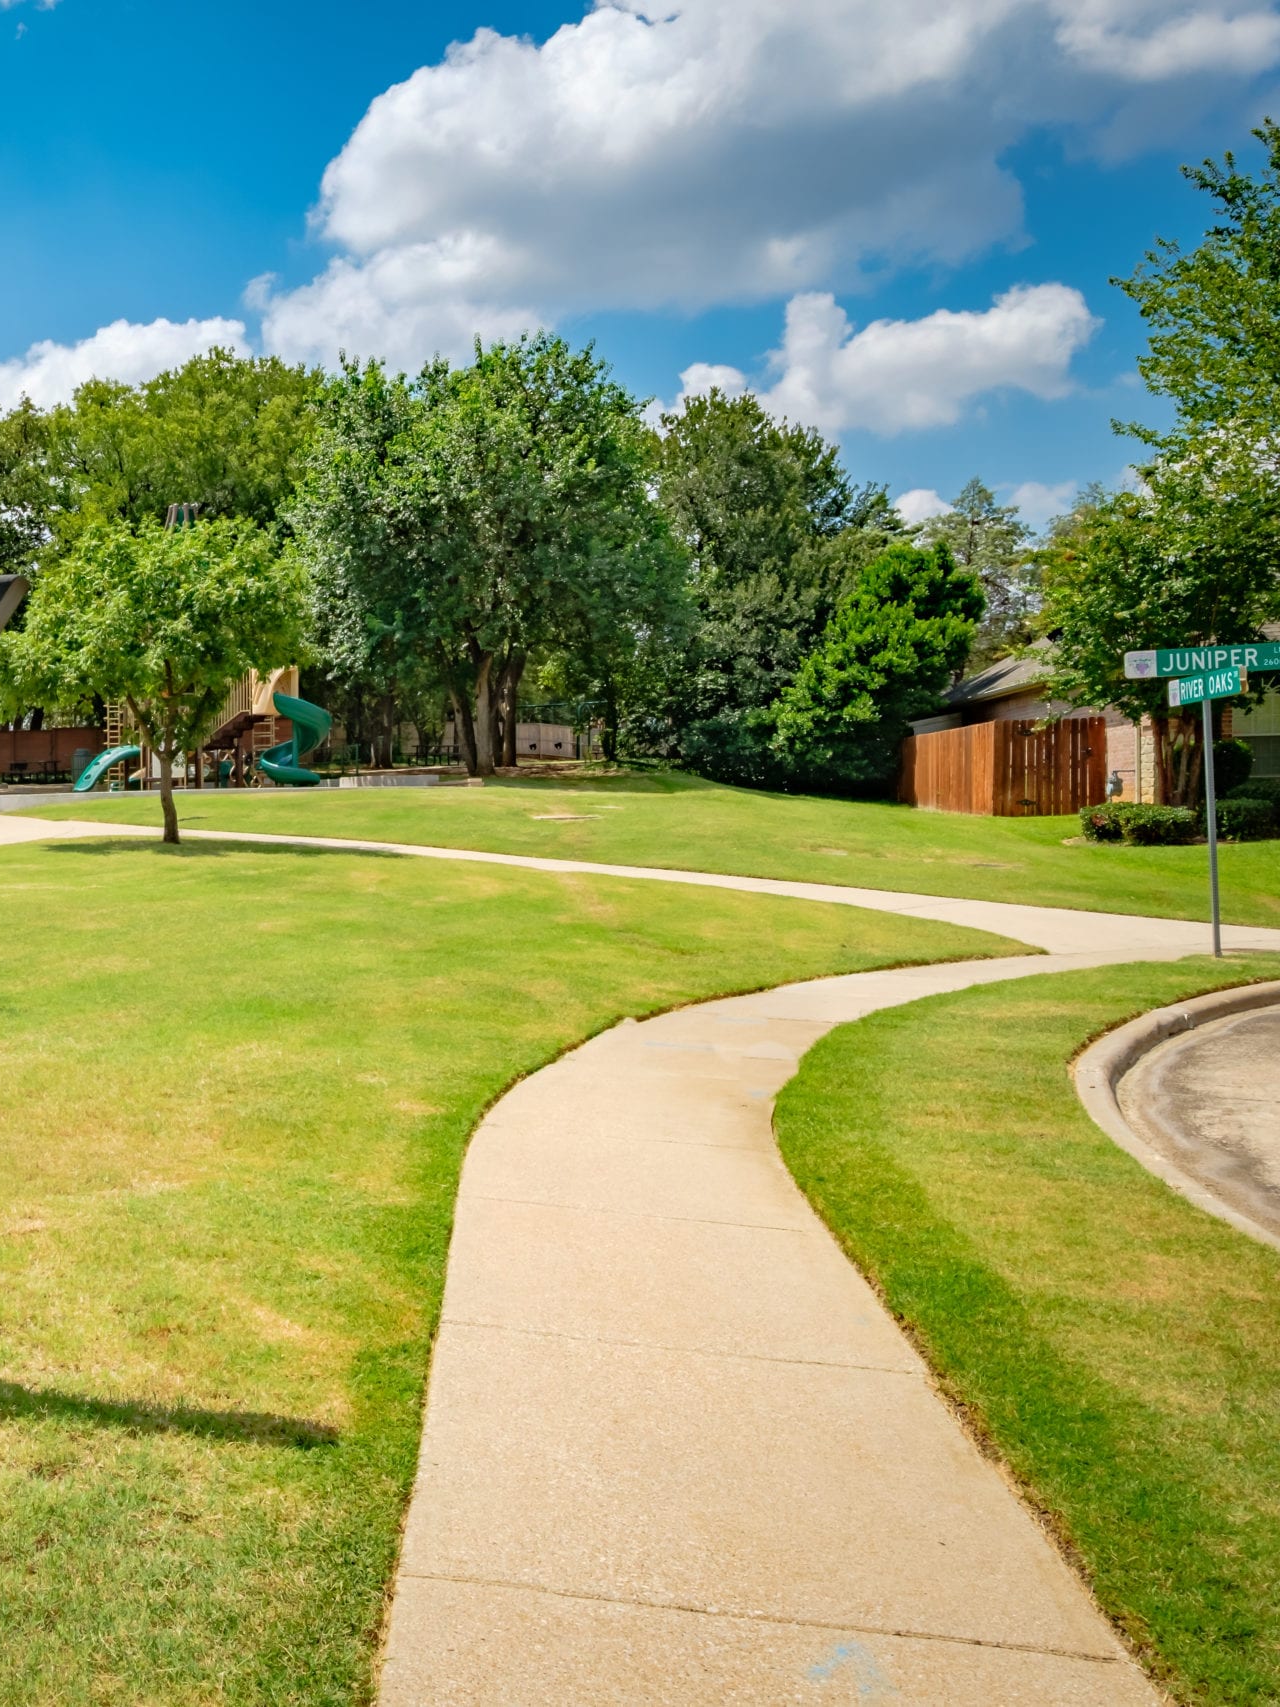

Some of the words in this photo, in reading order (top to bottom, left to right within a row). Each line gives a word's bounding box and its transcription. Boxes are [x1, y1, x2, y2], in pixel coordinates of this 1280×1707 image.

[1163, 648, 1258, 671] JUNIPER
[1263, 657, 1280, 666] 260
[1180, 678, 1204, 700] RIVER
[1208, 671, 1234, 694] OAKS
